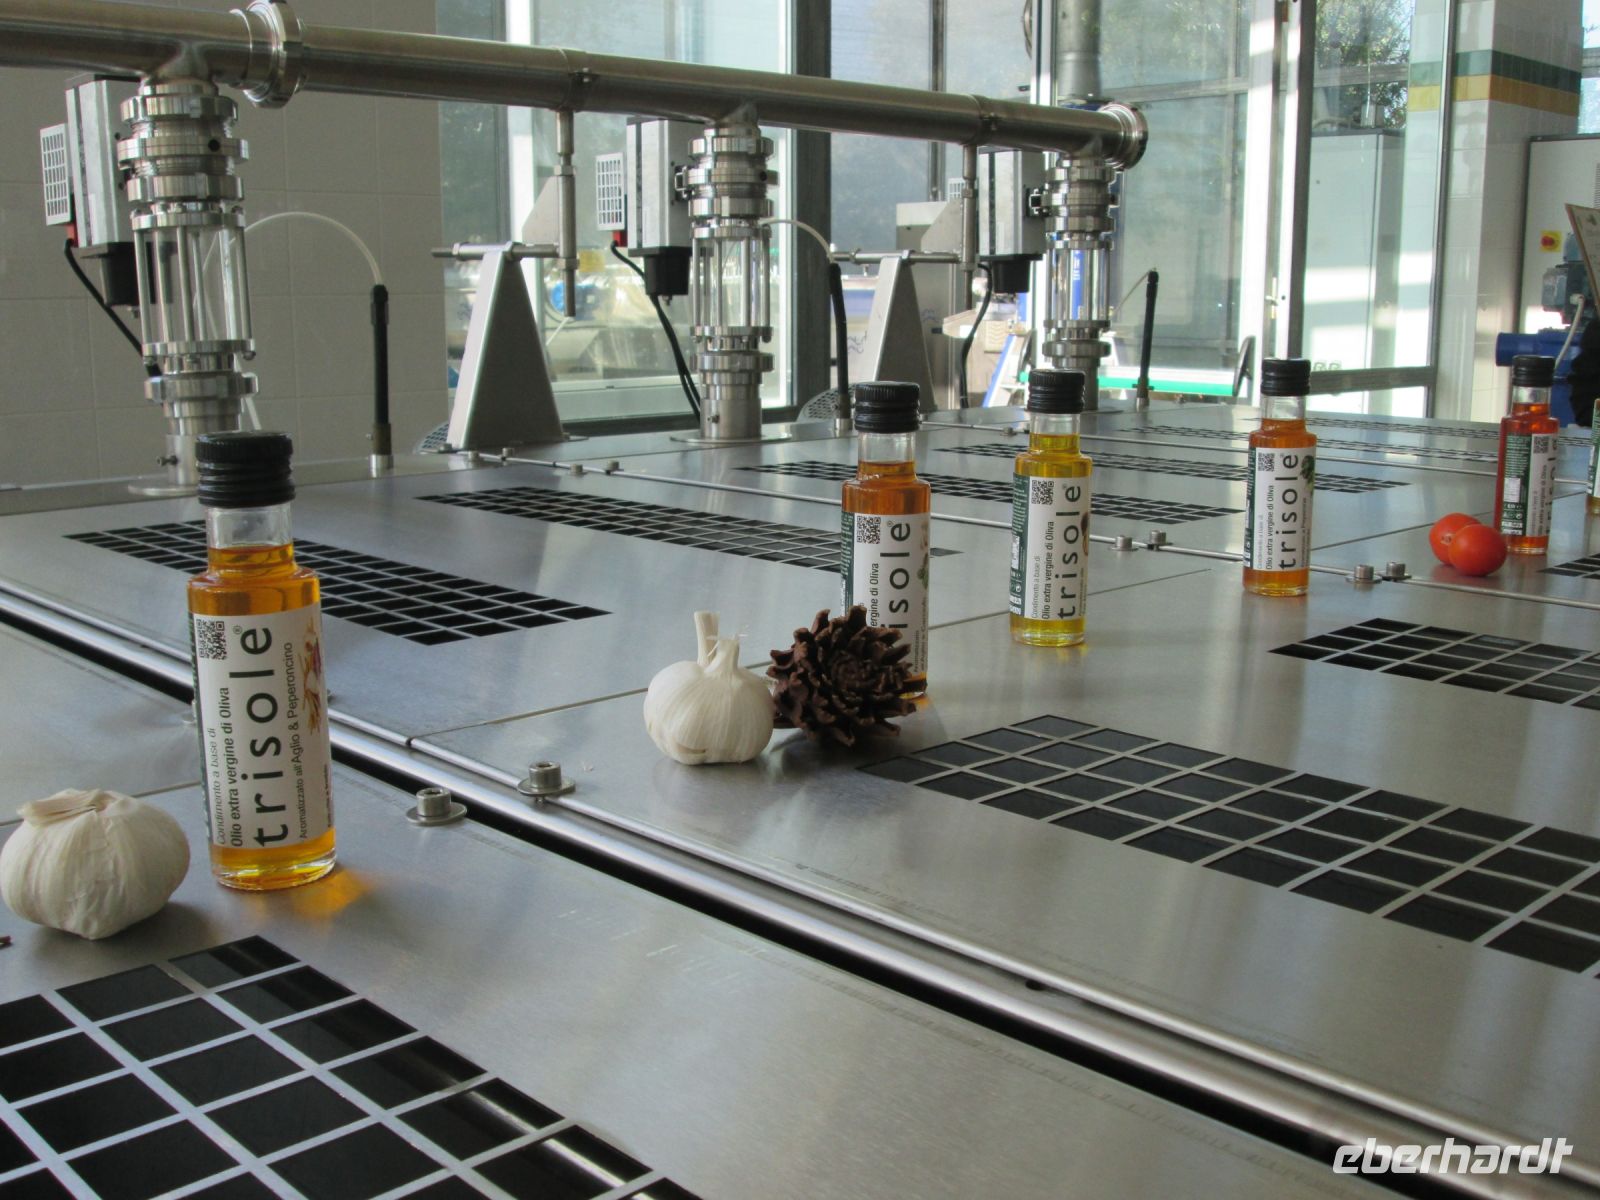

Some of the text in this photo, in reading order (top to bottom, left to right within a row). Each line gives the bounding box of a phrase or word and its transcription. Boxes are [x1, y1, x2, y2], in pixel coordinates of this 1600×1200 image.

[1267, 512, 1275, 536] vergine
[1275, 455, 1298, 569] trisole
[1046, 521, 1054, 540] Oliva
[1045, 553, 1054, 580] vergine
[870, 563, 880, 627] ergine di Oliva
[1043, 583, 1051, 603] extra
[1042, 605, 1050, 619] Olio
[283, 642, 299, 718] Peperoncino
[207, 727, 217, 738] di
[288, 721, 299, 731] &
[208, 741, 219, 768] base
[218, 687, 243, 847] Olio extra vergine di Oliva
[211, 781, 226, 845] Condimento
[297, 779, 308, 839] Aromatizzato
